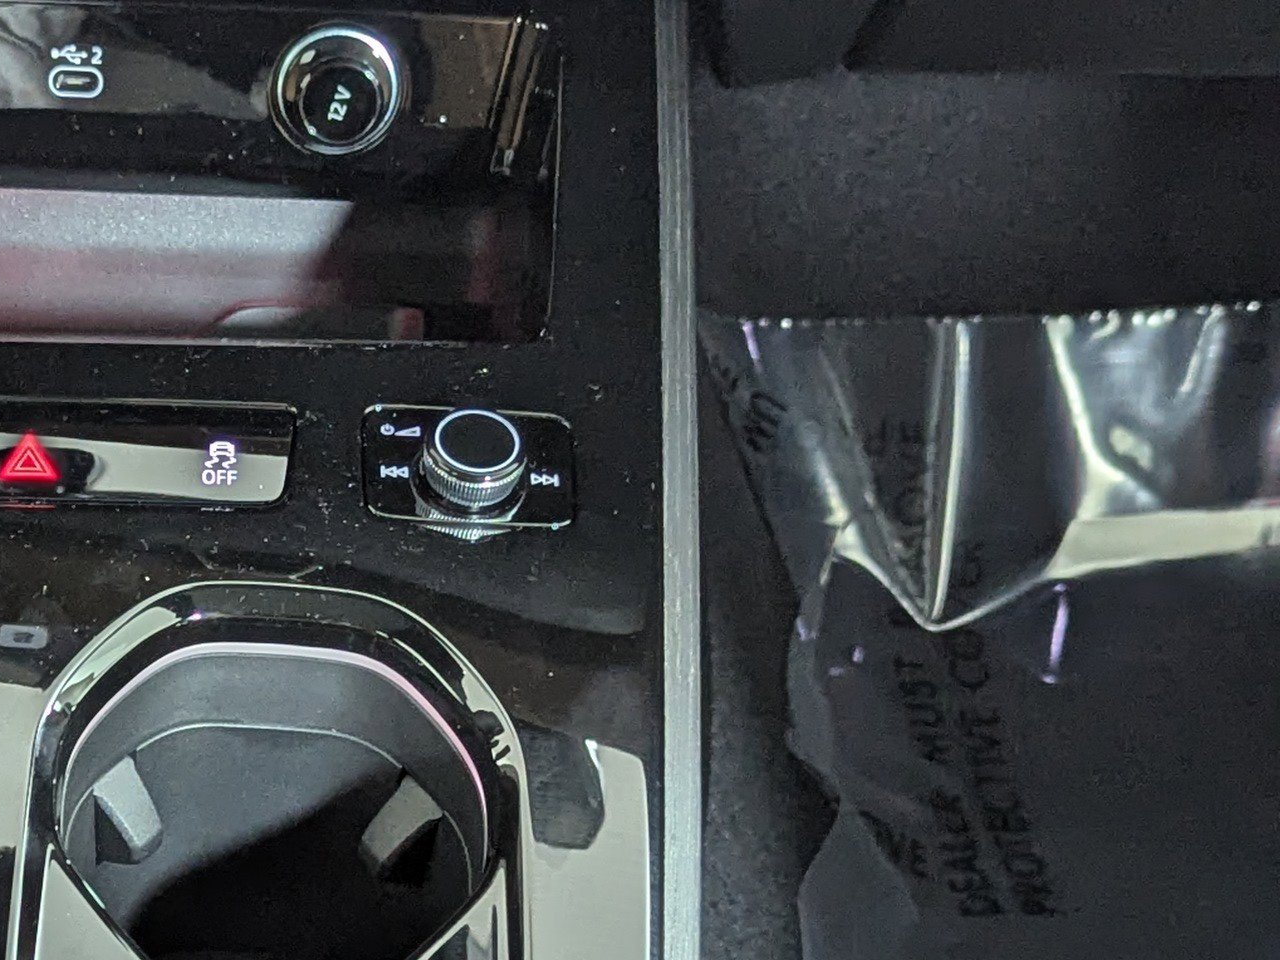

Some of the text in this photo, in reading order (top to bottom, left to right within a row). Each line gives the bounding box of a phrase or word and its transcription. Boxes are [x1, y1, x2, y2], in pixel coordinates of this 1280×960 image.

[91, 47, 103, 65] 2
[326, 84, 353, 121] 12V
[201, 468, 237, 486] OFF
